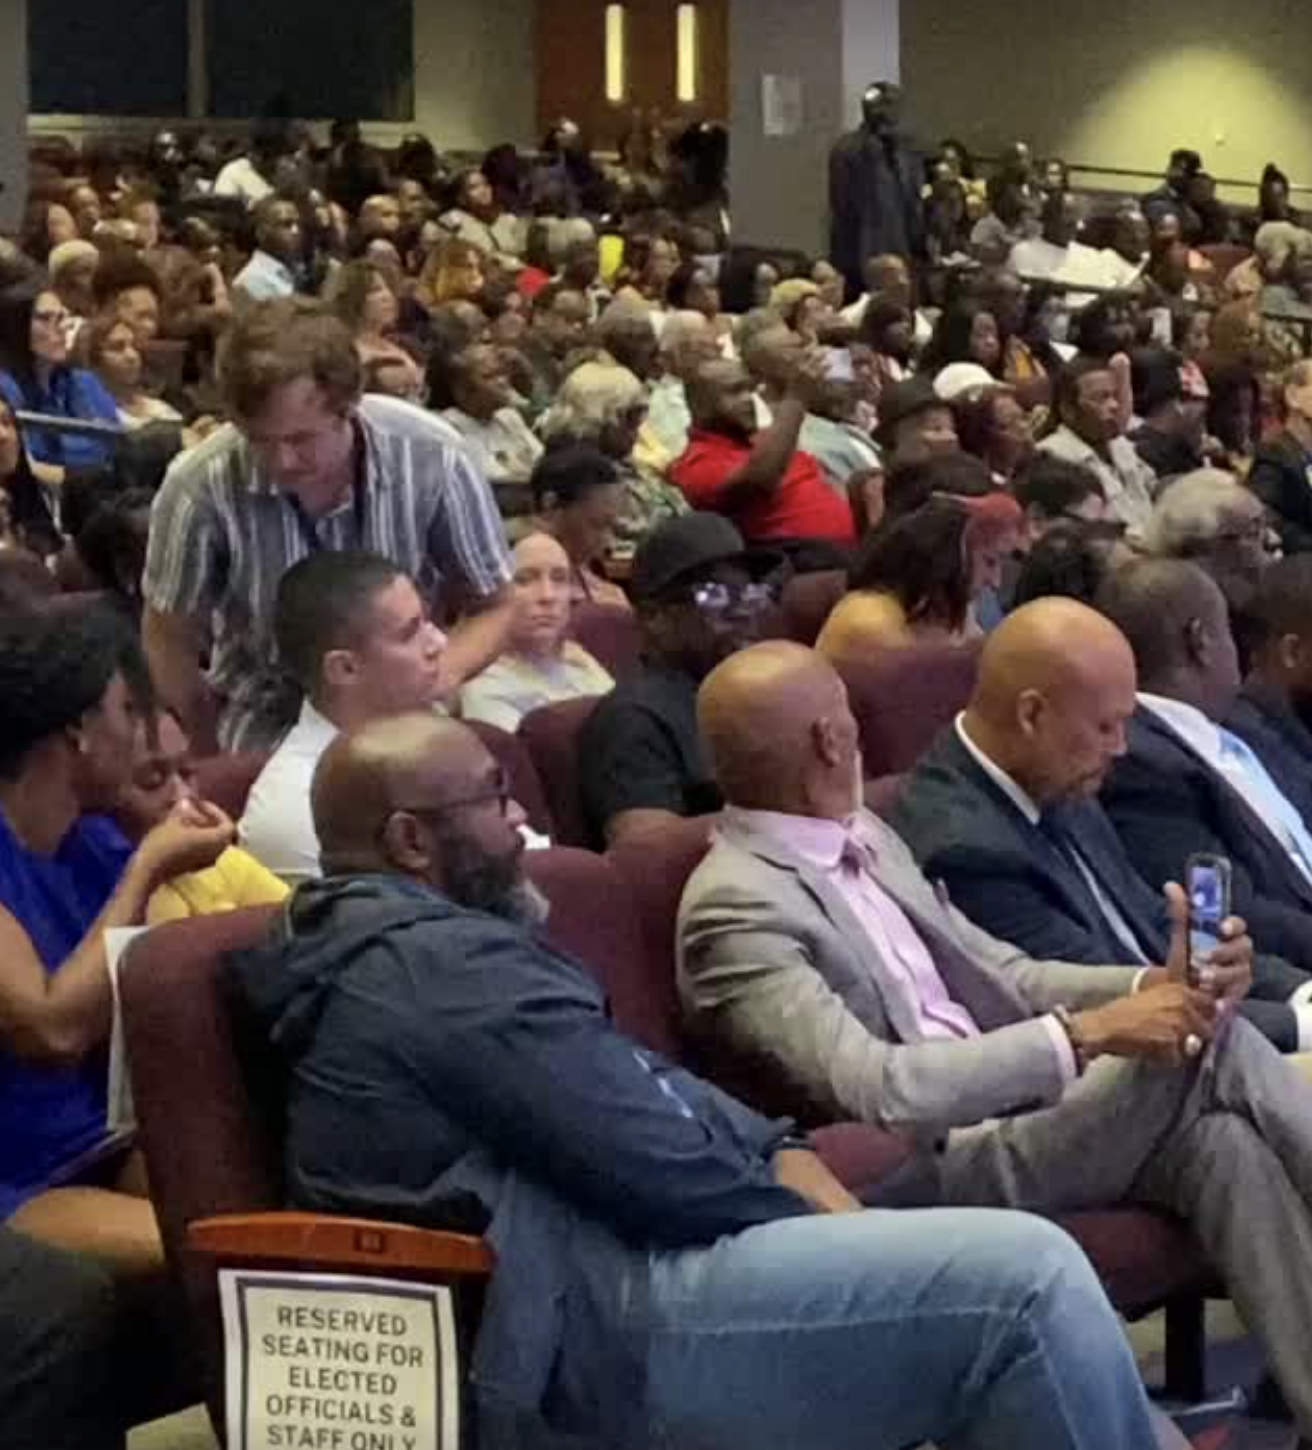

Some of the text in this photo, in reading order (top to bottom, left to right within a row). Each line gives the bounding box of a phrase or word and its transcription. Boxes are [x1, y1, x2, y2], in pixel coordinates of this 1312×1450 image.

[278, 1306, 406, 1336] RESERVED
[262, 1335, 423, 1367] SEATING FOR
[289, 1367, 397, 1395] ELECTED
[266, 1395, 416, 1427] OFFICIALS &
[267, 1425, 343, 1449] STAFF
